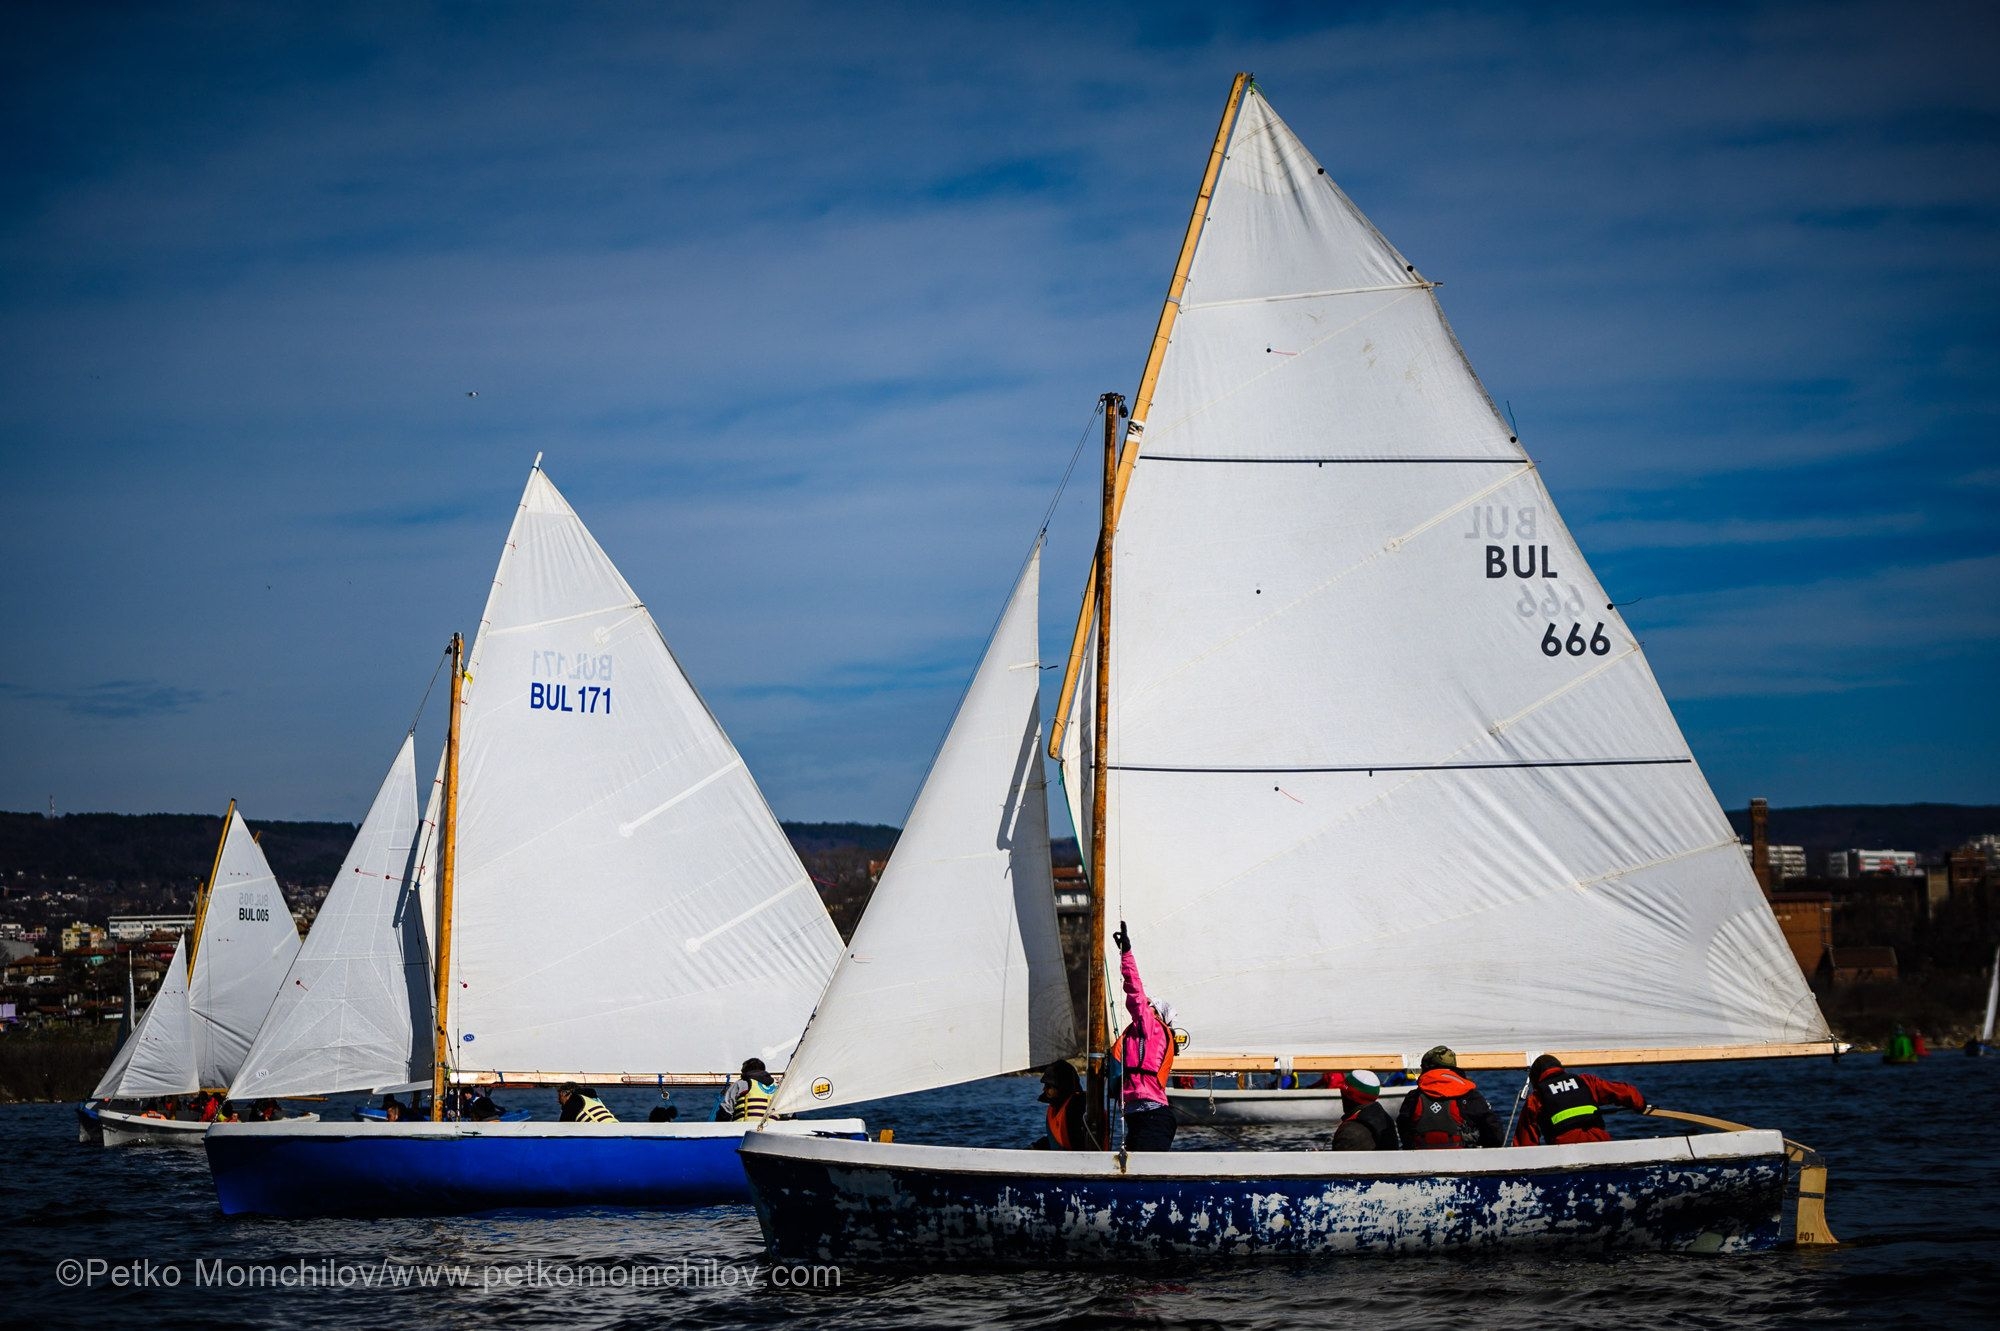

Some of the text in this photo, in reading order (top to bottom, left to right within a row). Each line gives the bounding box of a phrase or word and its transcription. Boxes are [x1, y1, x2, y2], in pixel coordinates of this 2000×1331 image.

[1486, 545, 1558, 579] BUL
[1541, 621, 1611, 657] 666
[530, 682, 611, 714] BUL 171
[239, 907, 270, 922] BUL 005
[1548, 1078, 1579, 1095] HH
[1798, 1232, 1815, 1242] #01
